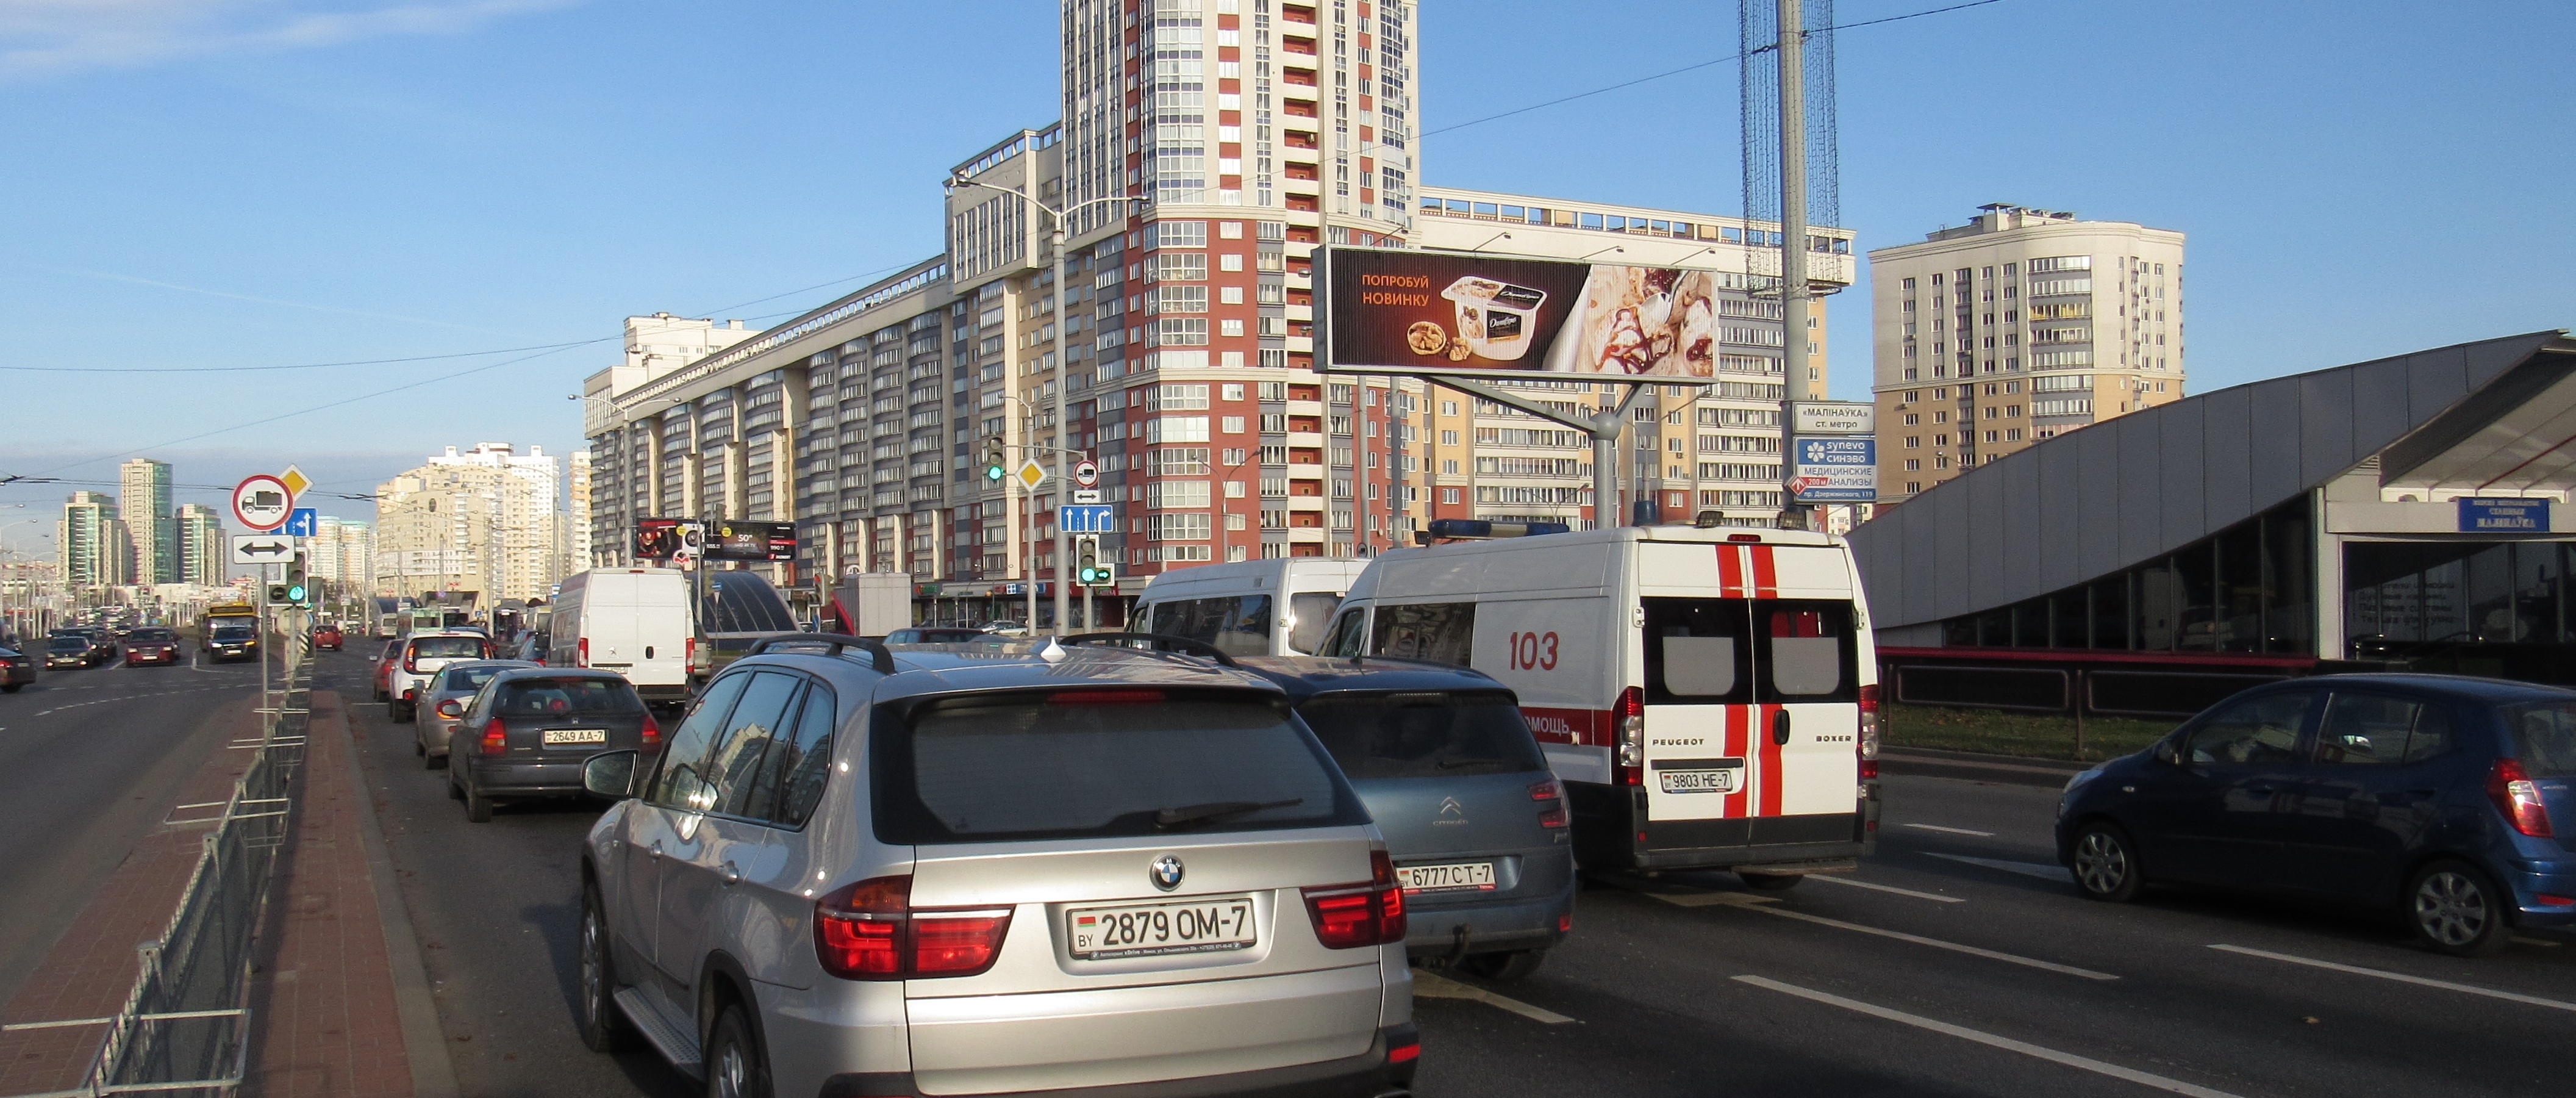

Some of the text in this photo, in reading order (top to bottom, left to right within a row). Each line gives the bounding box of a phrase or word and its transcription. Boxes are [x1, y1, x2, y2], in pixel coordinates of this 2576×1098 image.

[1362, 274, 1429, 289] ПОПРОБУЙ
[1362, 292, 1429, 307] НОВИНКУ
[1826, 442, 1865, 452] synevo
[1804, 467, 1872, 476] МЕДИЦИНСКИЕ
[1510, 631, 1559, 670] 103
[1525, 716, 1569, 737] МОЩЬ
[553, 731, 576, 742] 2649
[578, 731, 603, 741] AA-7
[1673, 773, 1728, 788] 9803 HE-7
[1412, 867, 1448, 886] 6777
[1101, 905, 1247, 946] 2879 OM-7
[1078, 934, 1093, 947] BY
